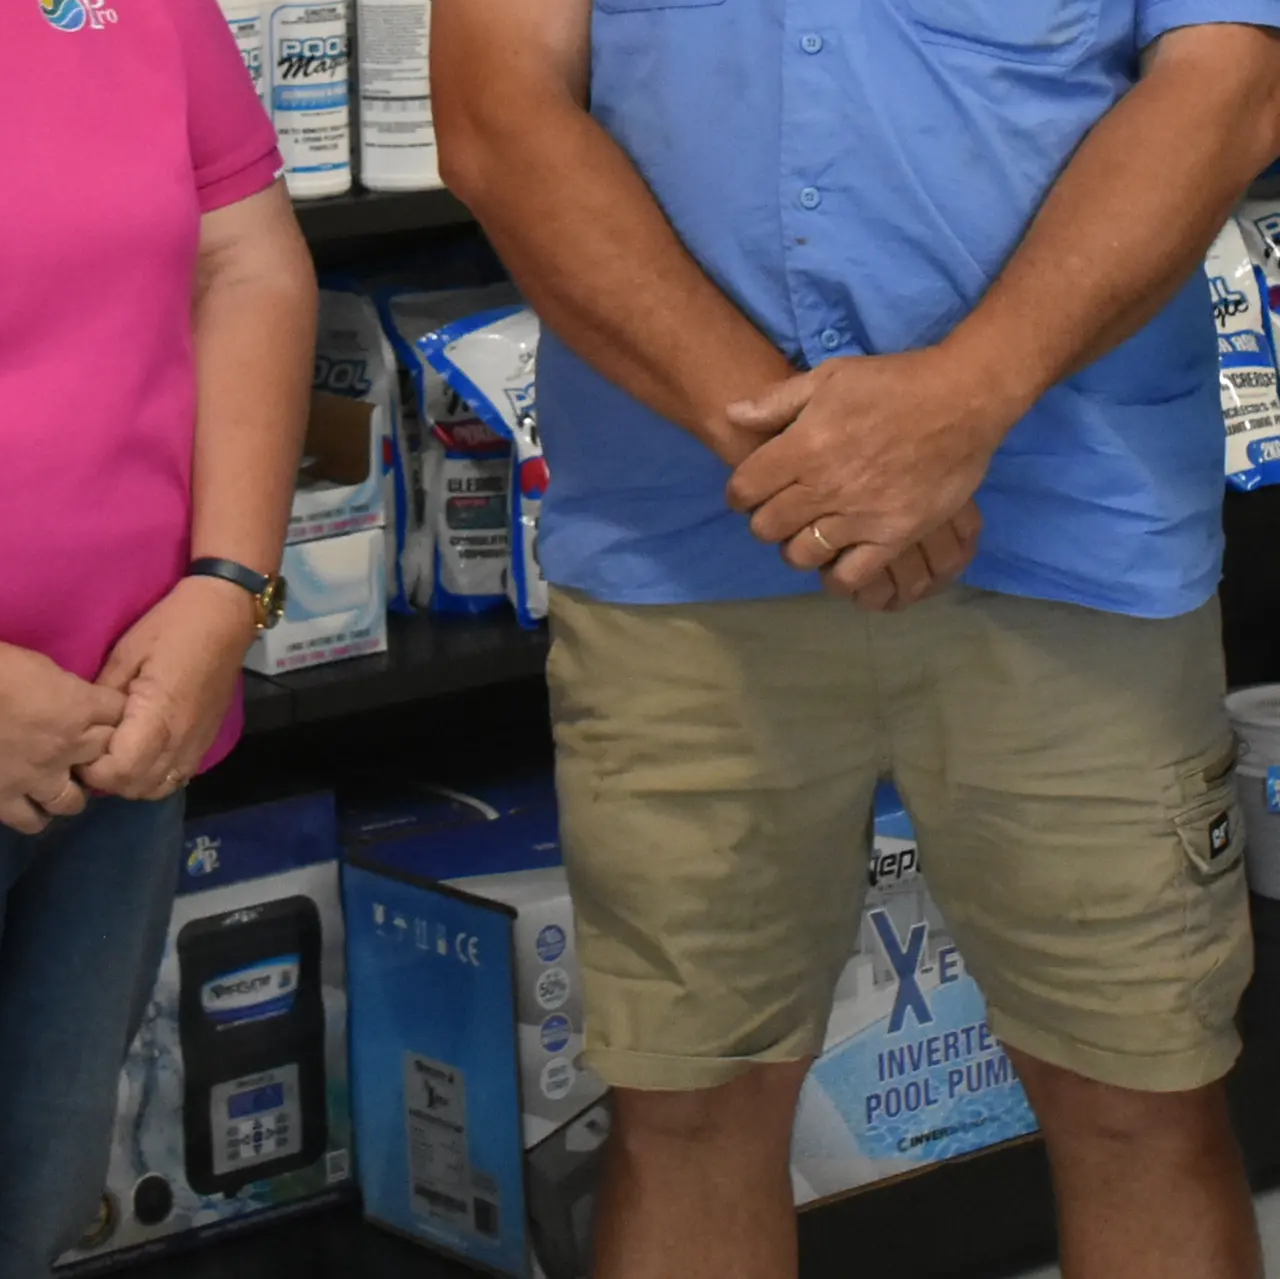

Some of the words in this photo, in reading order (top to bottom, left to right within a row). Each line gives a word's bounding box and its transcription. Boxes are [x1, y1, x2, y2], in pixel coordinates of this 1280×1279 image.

[877, 1022, 1003, 1083] INVERTE
[865, 1081, 939, 1126] POOL
[948, 1057, 1019, 1100] PUM
